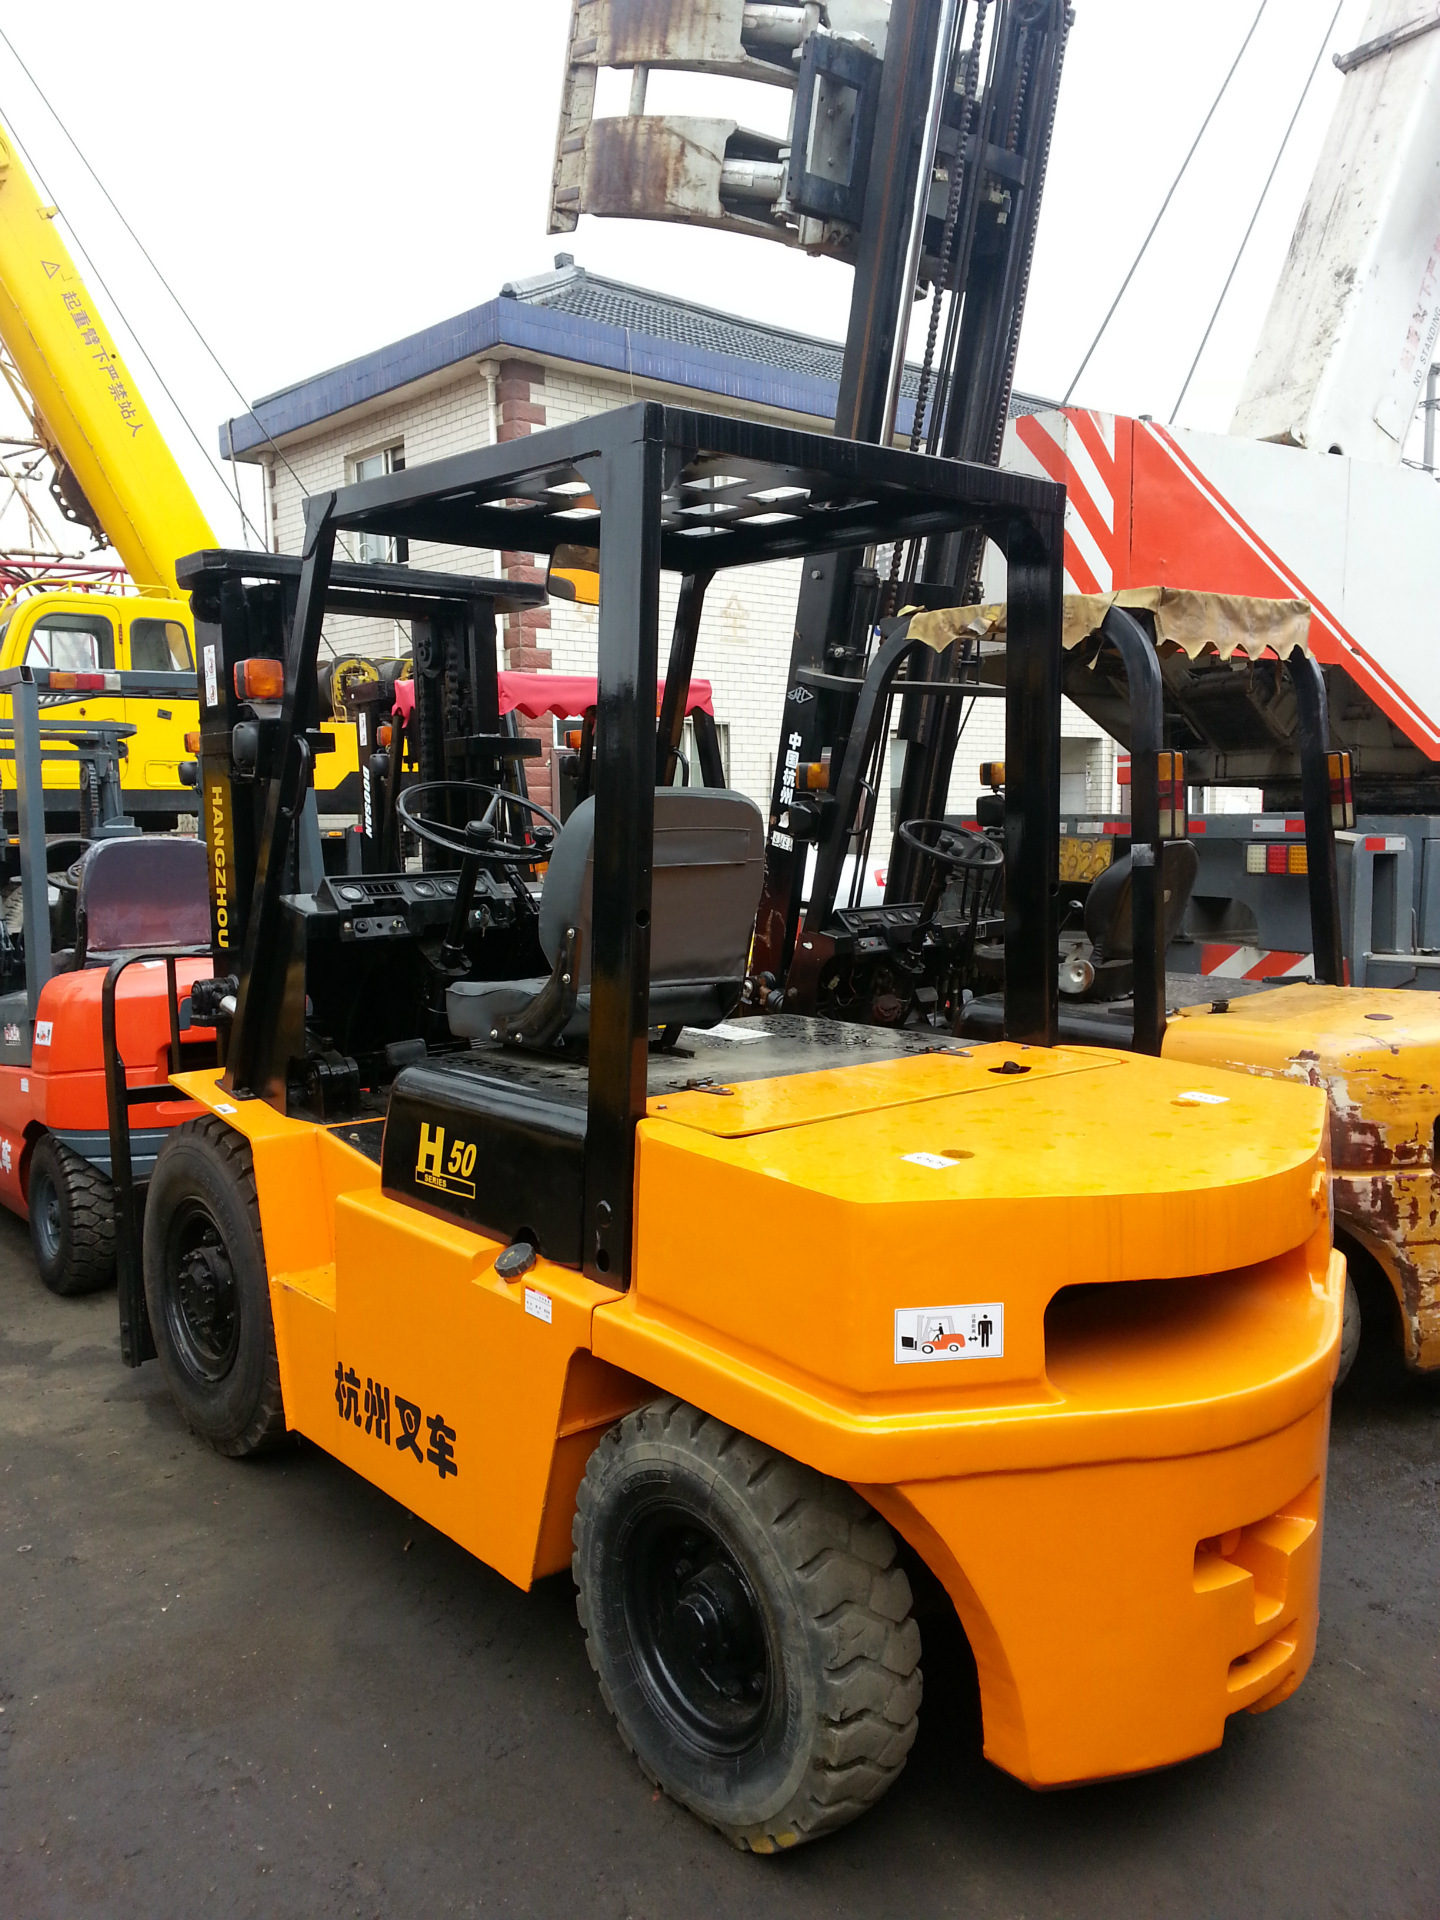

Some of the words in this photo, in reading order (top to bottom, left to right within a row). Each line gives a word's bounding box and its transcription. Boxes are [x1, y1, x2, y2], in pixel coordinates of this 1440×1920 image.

[61, 291, 143, 438] 起重臂下严禁站人
[1412, 369, 1423, 388] NO
[362, 765, 373, 839] DOOSAN
[780, 732, 802, 805] 中国杭州
[211, 786, 230, 948] HANGZHOU
[424, 1174, 447, 1188] SERIES
[448, 1140, 477, 1177] 50
[334, 1361, 458, 1480] 杭州叉车
